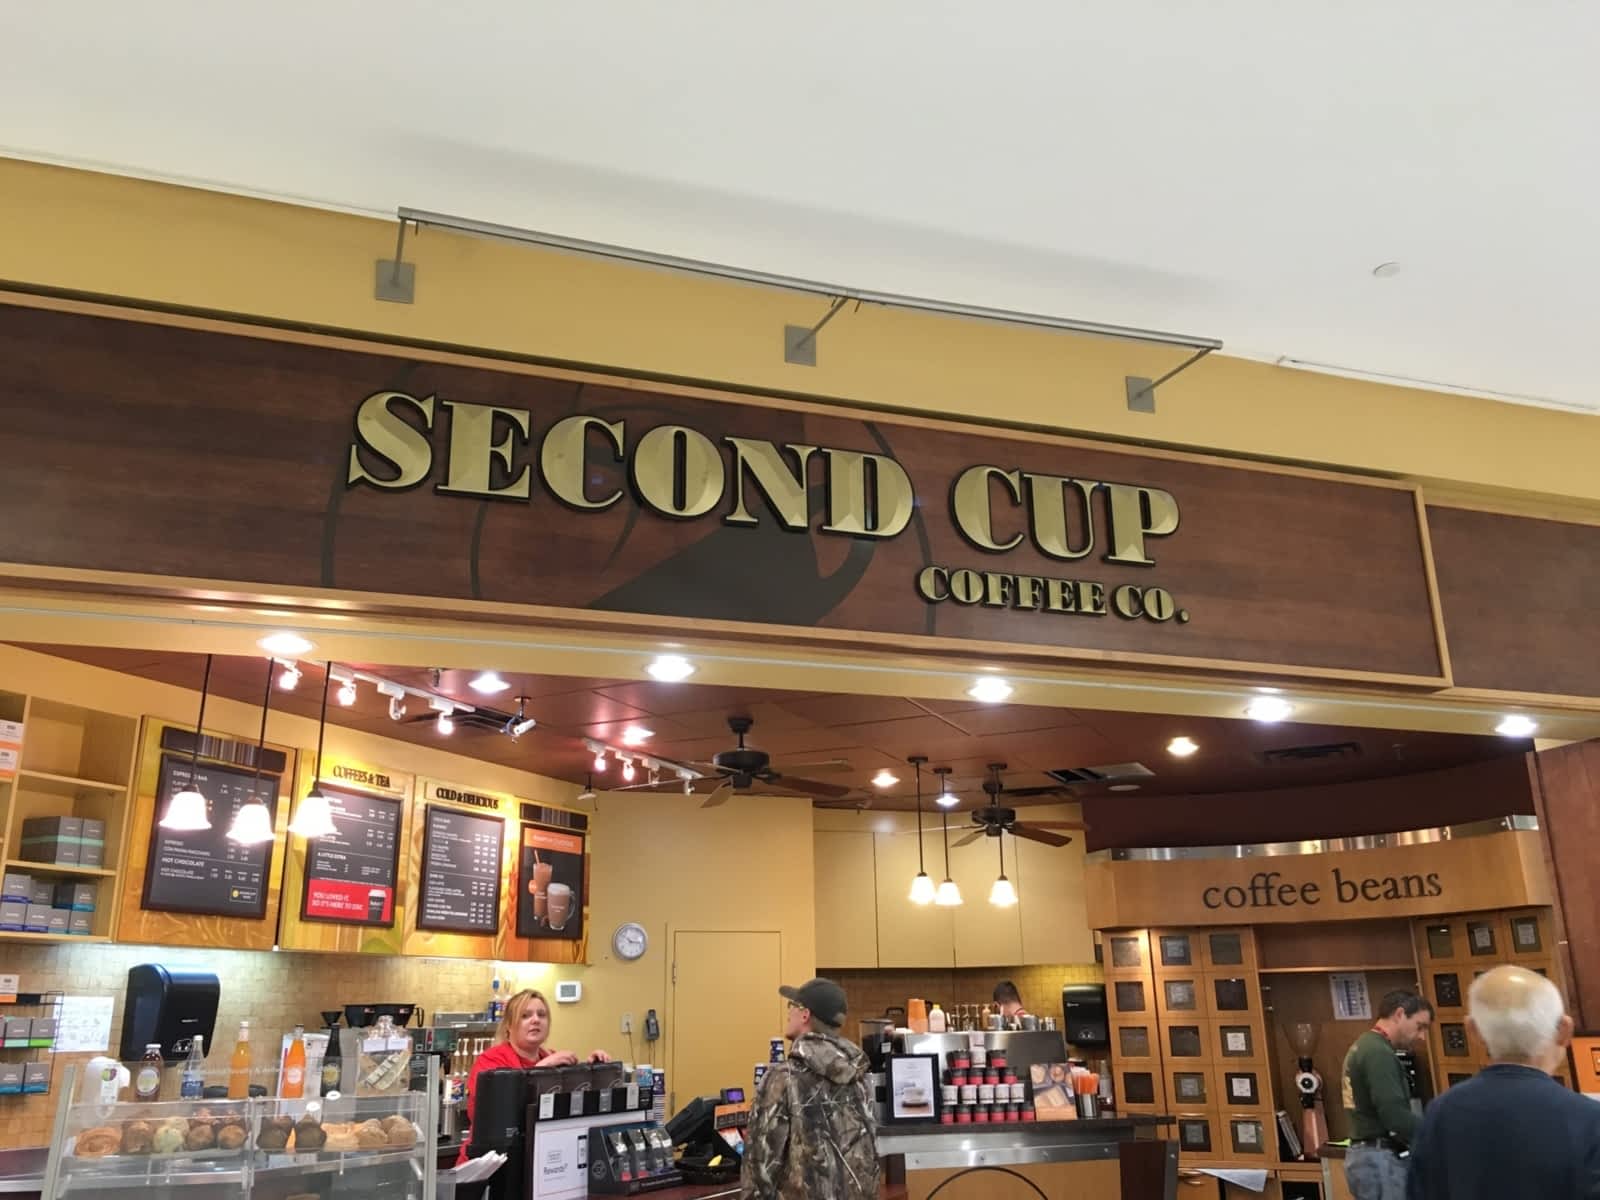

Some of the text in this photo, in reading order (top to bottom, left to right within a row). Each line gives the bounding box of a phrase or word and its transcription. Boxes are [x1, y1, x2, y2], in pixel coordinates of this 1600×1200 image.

[346, 391, 1181, 566] SECOND CUP
[917, 566, 1190, 623] COFFEE CO.
[333, 765, 368, 783] COFFEES
[375, 773, 390, 788] TEA
[436, 787, 457, 801] COLD
[463, 792, 499, 810] DELICIOUS
[1202, 867, 1443, 909] coffee beans
